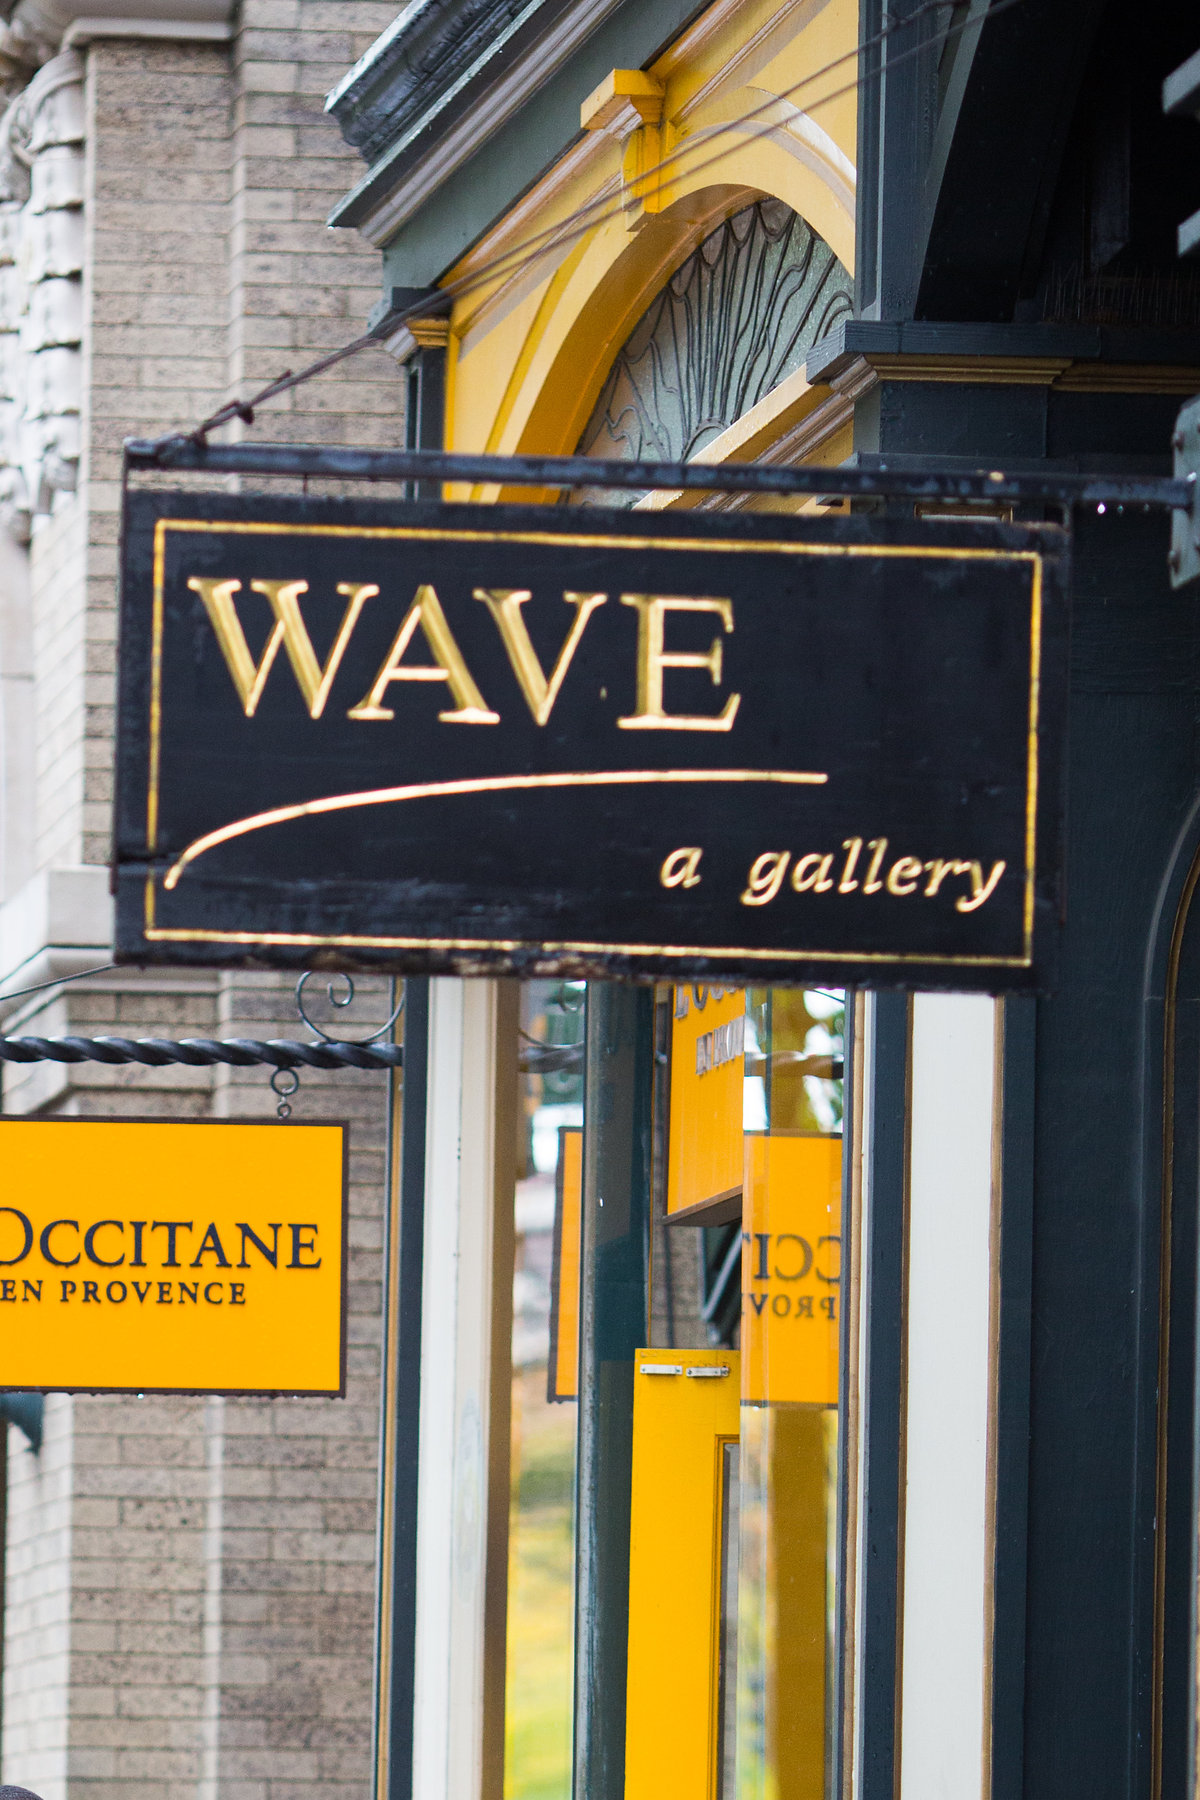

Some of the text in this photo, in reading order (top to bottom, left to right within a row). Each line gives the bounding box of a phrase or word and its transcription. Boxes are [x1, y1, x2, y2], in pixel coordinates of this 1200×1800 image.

[187, 575, 742, 732] WAVE
[661, 836, 1006, 913] a gallery
[0, 1279, 247, 1306] EN PROVENCE
